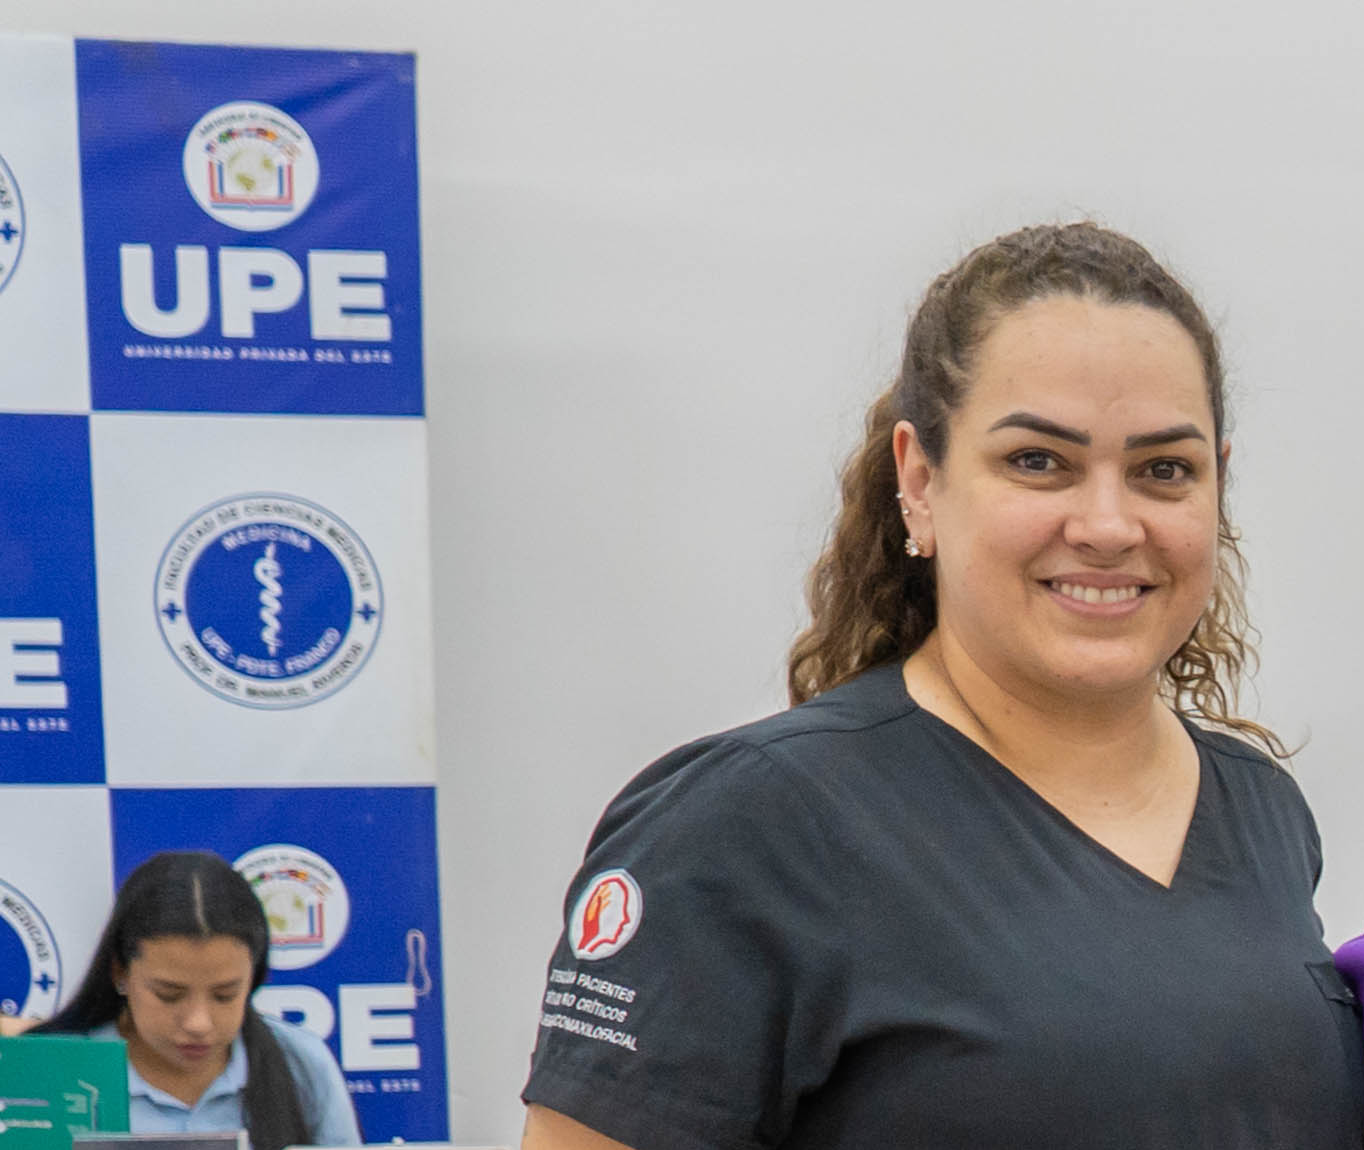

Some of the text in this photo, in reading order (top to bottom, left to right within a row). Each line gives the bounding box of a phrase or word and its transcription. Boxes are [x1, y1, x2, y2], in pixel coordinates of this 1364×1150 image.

[119, 243, 392, 342] UPE
[576, 973, 637, 1003] PACIENTES
[576, 997, 628, 1023] CRÍTICOS
[251, 983, 421, 1072] PE
